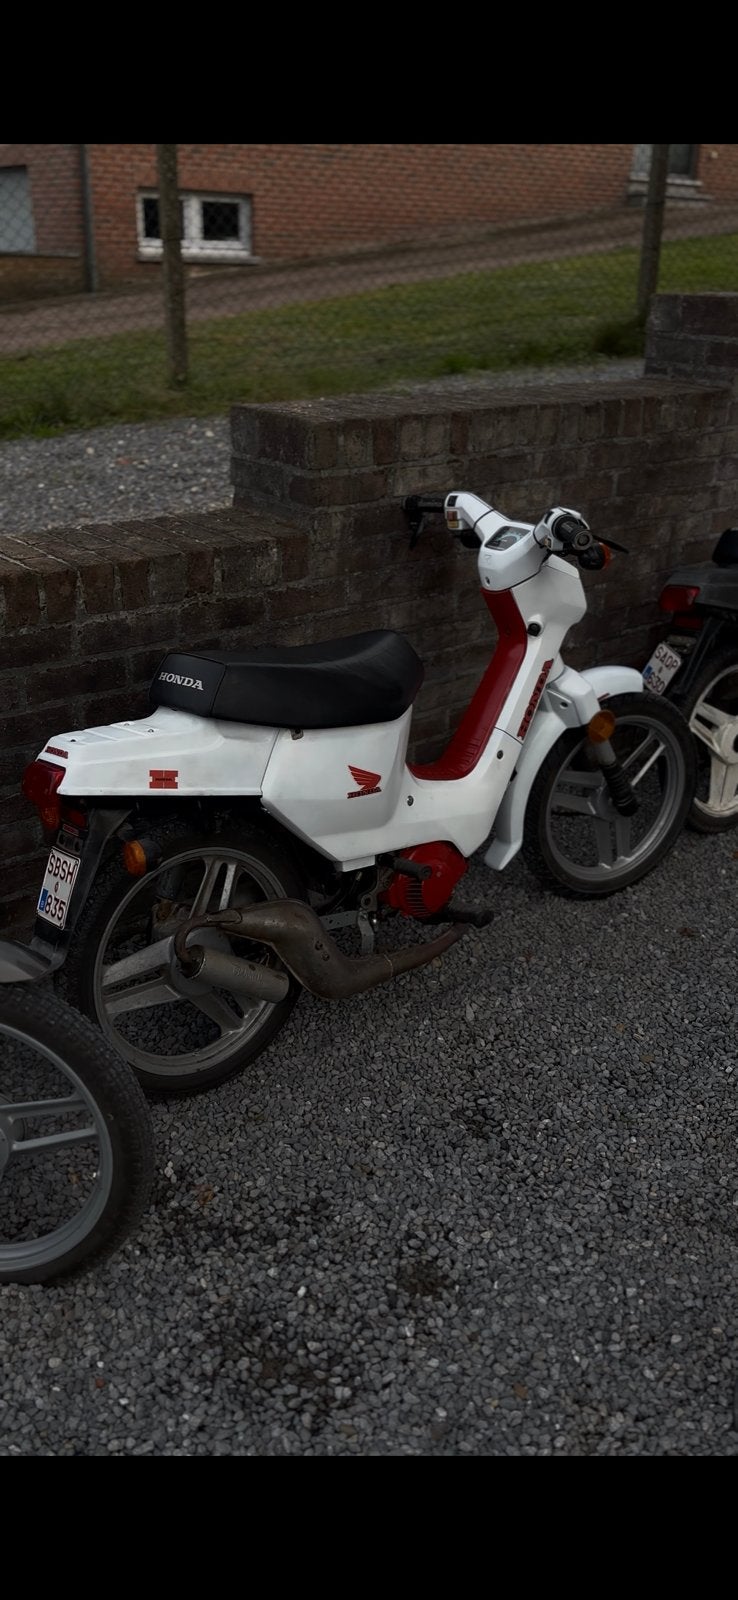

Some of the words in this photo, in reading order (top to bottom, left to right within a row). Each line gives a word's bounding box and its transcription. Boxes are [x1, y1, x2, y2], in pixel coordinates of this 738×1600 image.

[158, 671, 204, 690] HONDA
[647, 671, 666, 693] 630
[517, 658, 554, 741] HONDA
[347, 786, 382, 799] HONDA
[48, 854, 78, 884] SBSH
[44, 894, 66, 921] 835
